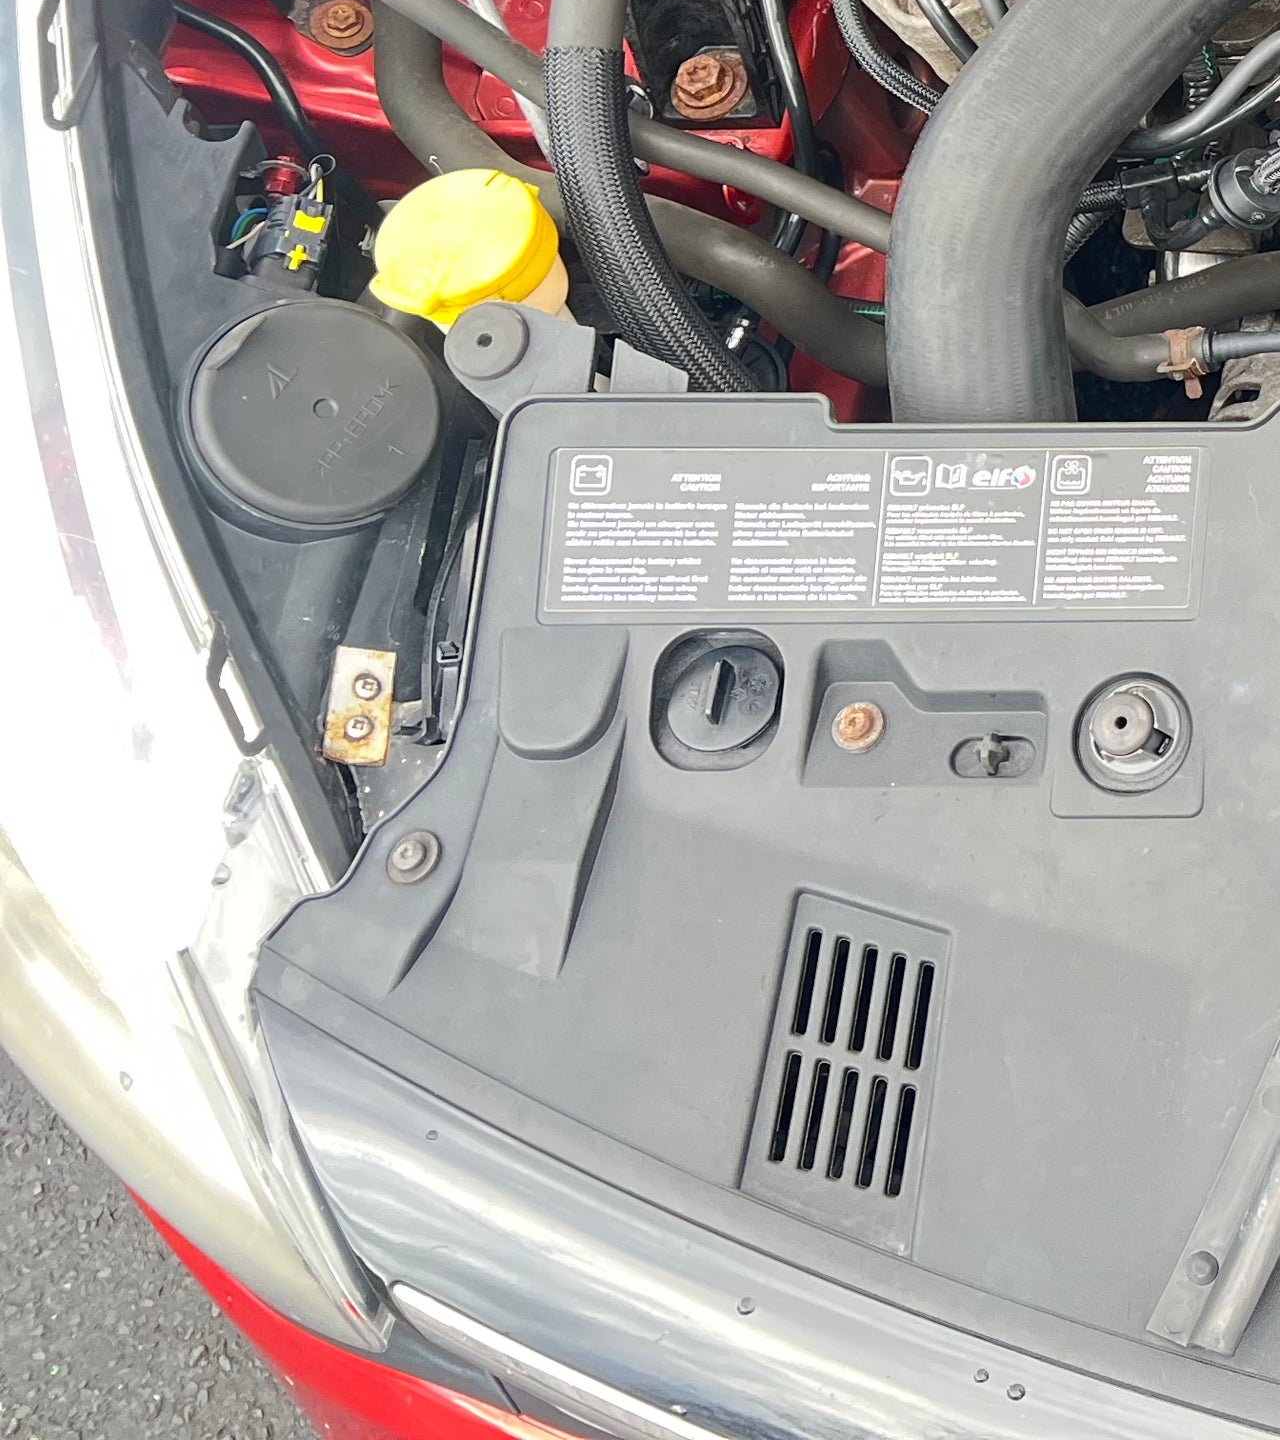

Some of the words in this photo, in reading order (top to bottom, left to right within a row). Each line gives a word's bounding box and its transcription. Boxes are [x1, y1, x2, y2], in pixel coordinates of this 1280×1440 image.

[1143, 455, 1192, 464] ATTENTION
[1152, 465, 1191, 473] CAUTION
[671, 473, 722, 482] ATTENTION
[826, 473, 871, 482] ACHTUNG
[972, 468, 1014, 486] elf
[1147, 474, 1190, 483] ACHTUNG
[680, 482, 721, 492] CAUTION
[1145, 484, 1189, 493] ATENCION
